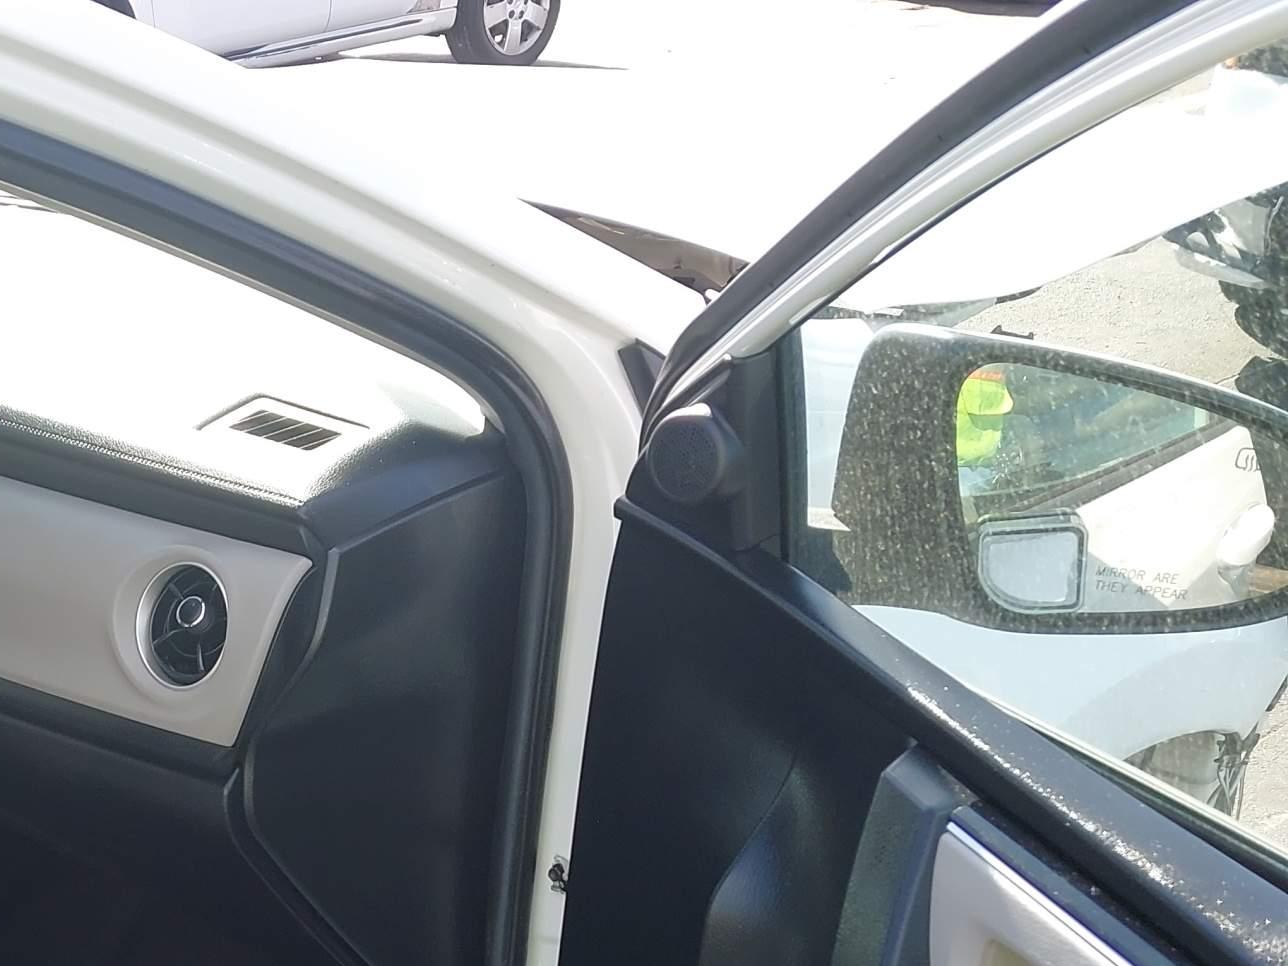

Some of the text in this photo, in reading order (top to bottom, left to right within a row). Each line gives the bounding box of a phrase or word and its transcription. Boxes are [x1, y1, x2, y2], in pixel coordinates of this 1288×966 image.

[1095, 566, 1179, 585] MIRROR ARE
[1095, 579, 1189, 600] THEY APPEAR
